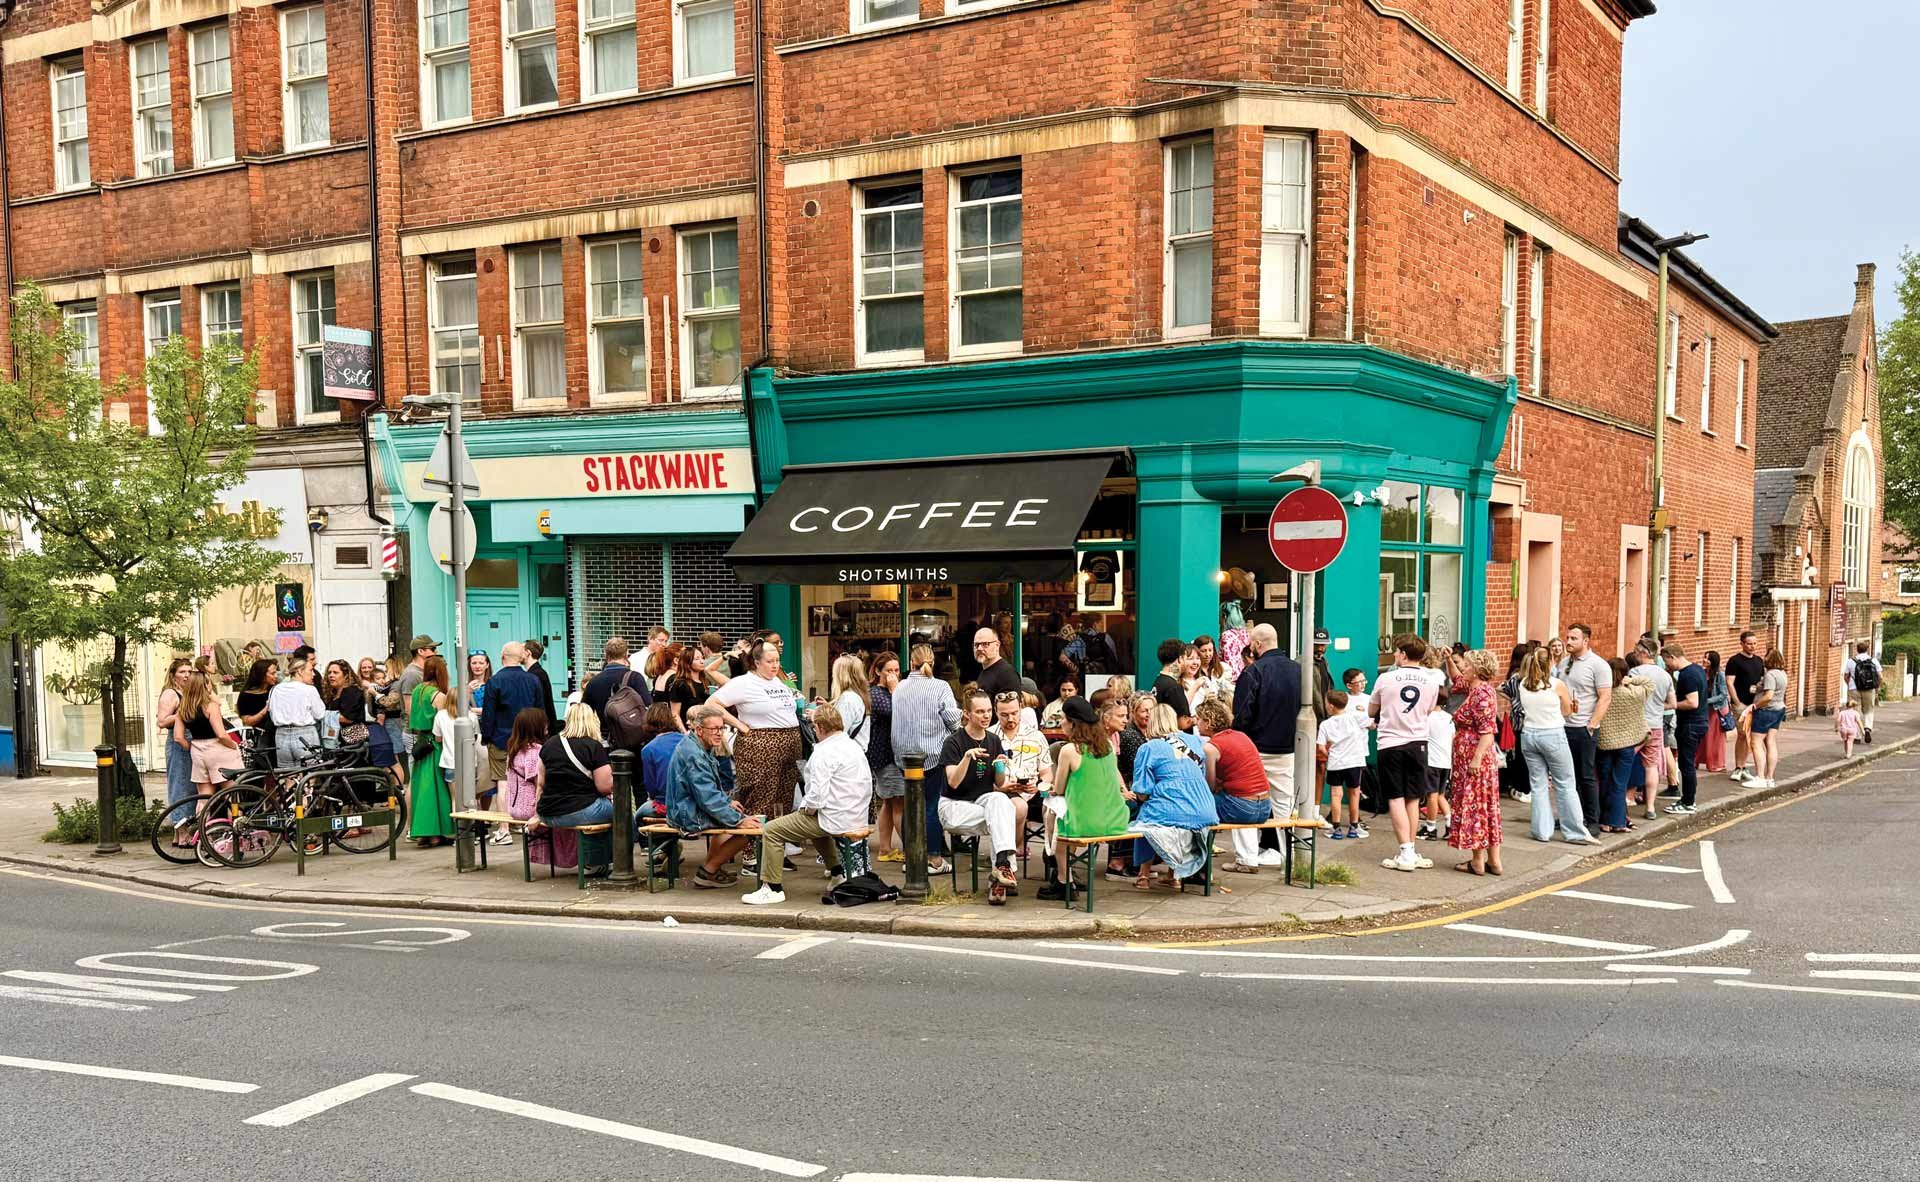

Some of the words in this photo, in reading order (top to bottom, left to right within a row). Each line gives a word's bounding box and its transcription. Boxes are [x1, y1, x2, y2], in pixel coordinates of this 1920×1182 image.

[338, 368, 373, 387] Sold
[583, 452, 728, 493] STACKWAVE
[789, 498, 1049, 532] COFFEE
[838, 567, 949, 582] SHOTSMITHS
[279, 616, 304, 628] NAILS
[1400, 685, 1421, 714] 9
